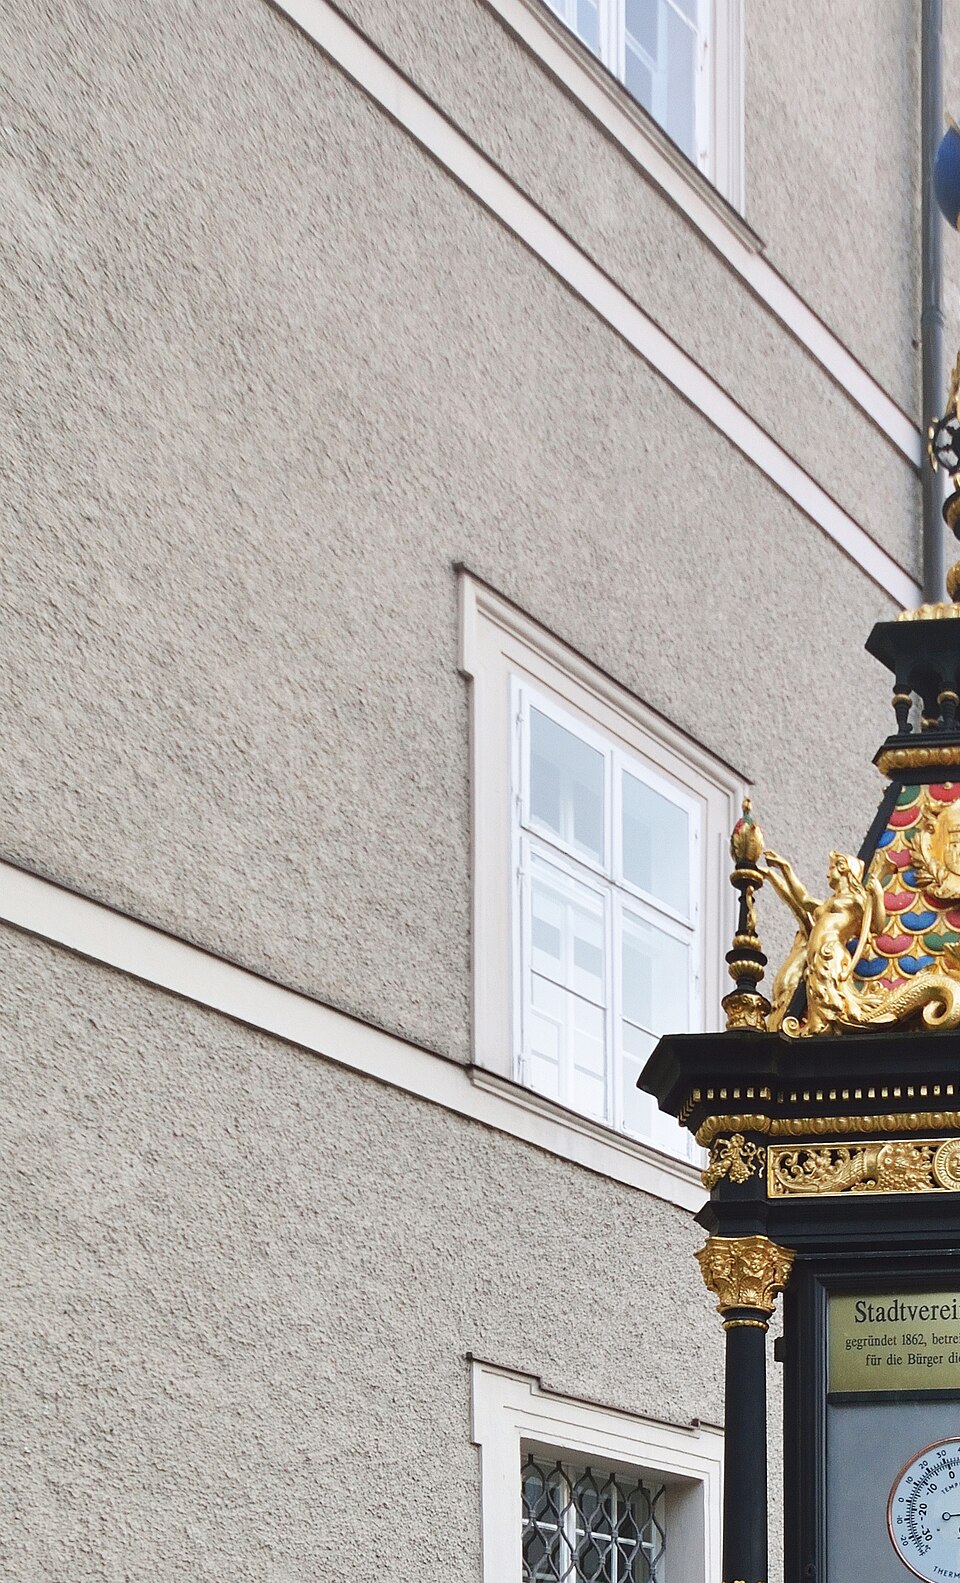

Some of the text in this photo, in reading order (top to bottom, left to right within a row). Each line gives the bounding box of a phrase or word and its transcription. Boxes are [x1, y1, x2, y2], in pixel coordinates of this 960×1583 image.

[845, 1335, 897, 1350] gegründet
[901, 1333, 927, 1347] 1862,
[866, 1354, 882, 1366] für
[886, 1353, 902, 1366] die
[907, 1353, 943, 1368] Bürger
[936, 1450, 946, 1458] 30
[919, 1460, 928, 1469] 20
[948, 1471, 955, 1479] 0
[906, 1476, 914, 1484] 10
